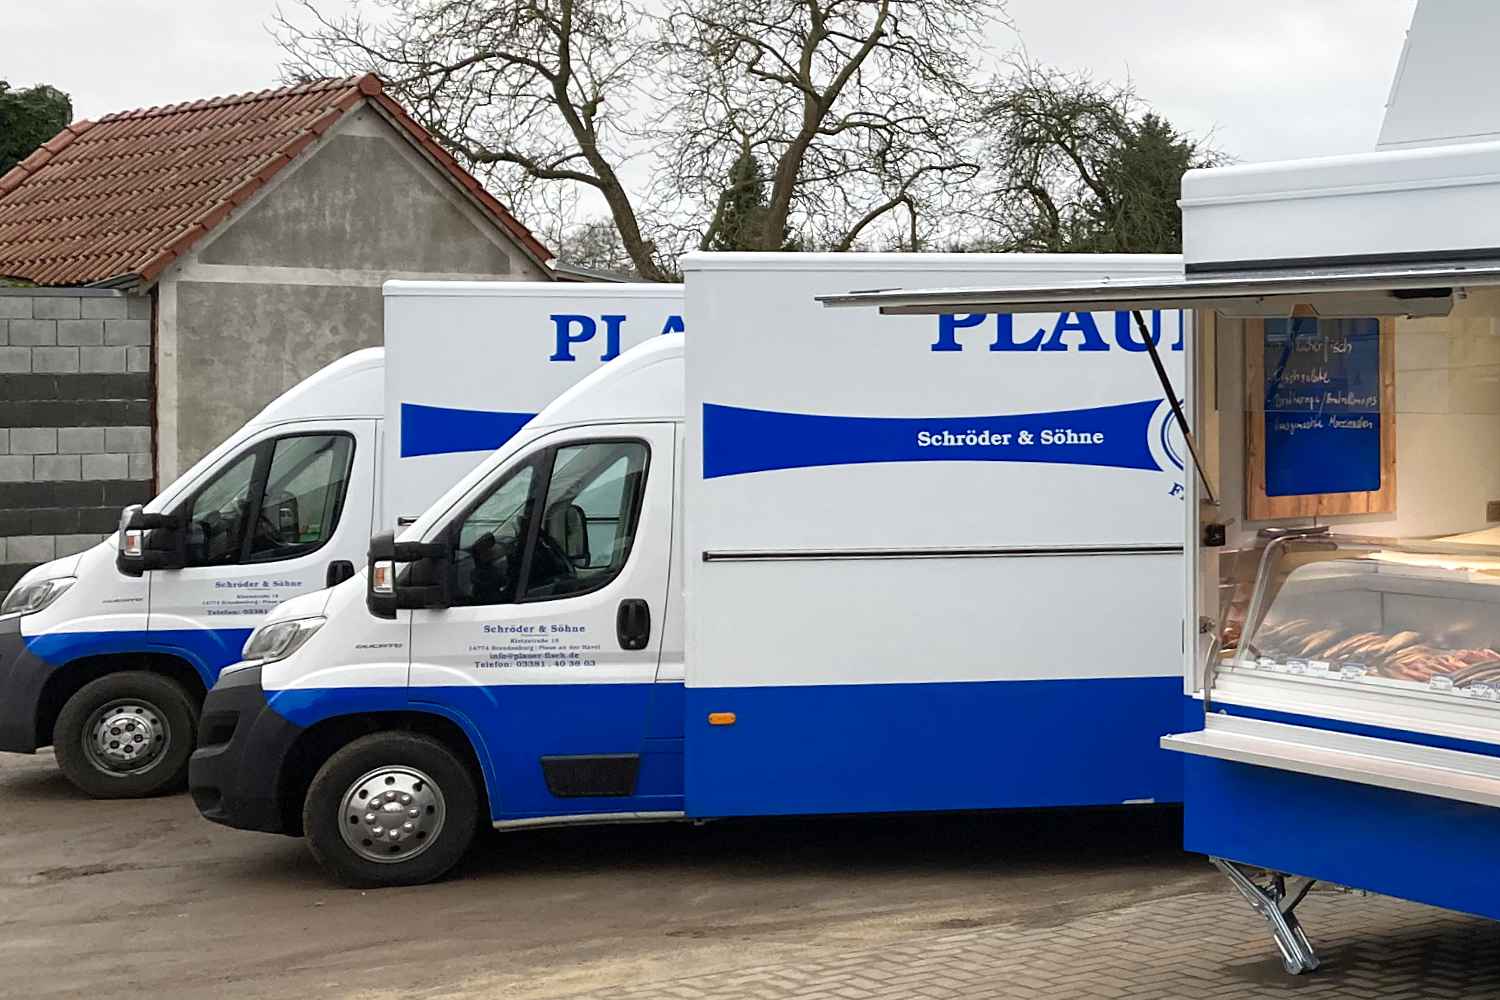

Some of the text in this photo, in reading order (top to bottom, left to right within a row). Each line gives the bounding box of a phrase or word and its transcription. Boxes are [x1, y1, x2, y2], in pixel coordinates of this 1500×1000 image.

[931, 308, 1184, 351] PLAU
[918, 429, 1104, 446] Schröder & Söhne
[483, 624, 586, 633] Schröder & Söhne
